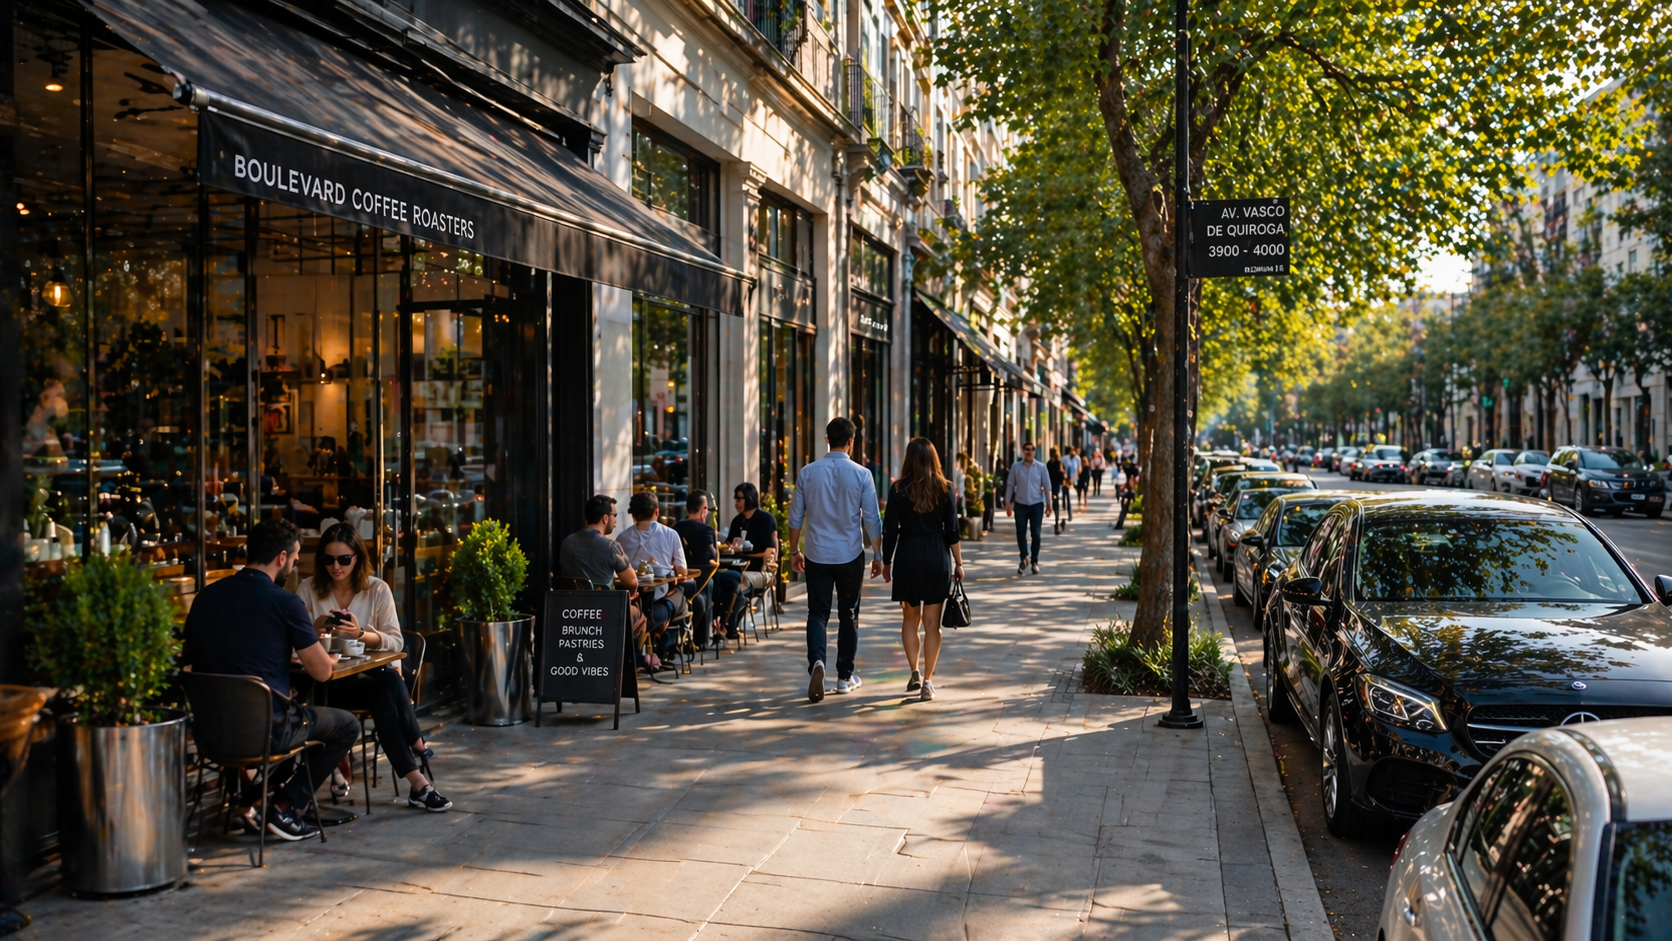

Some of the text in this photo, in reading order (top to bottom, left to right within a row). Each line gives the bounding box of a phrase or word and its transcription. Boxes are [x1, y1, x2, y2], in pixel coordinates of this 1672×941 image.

[234, 153, 475, 239] BOULEVARD COFFEE ROASTERS
[1221, 205, 1285, 219] AV. VASCO
[1206, 223, 1285, 237] DE QUIROGA
[1208, 245, 1240, 257] 3900
[1253, 243, 1285, 256] 4000
[562, 608, 603, 620] COFFEE
[561, 625, 603, 636] BRUNCH
[558, 639, 605, 649] PASTRIES
[576, 652, 584, 663] &
[550, 666, 609, 677] GOOD VIBES
